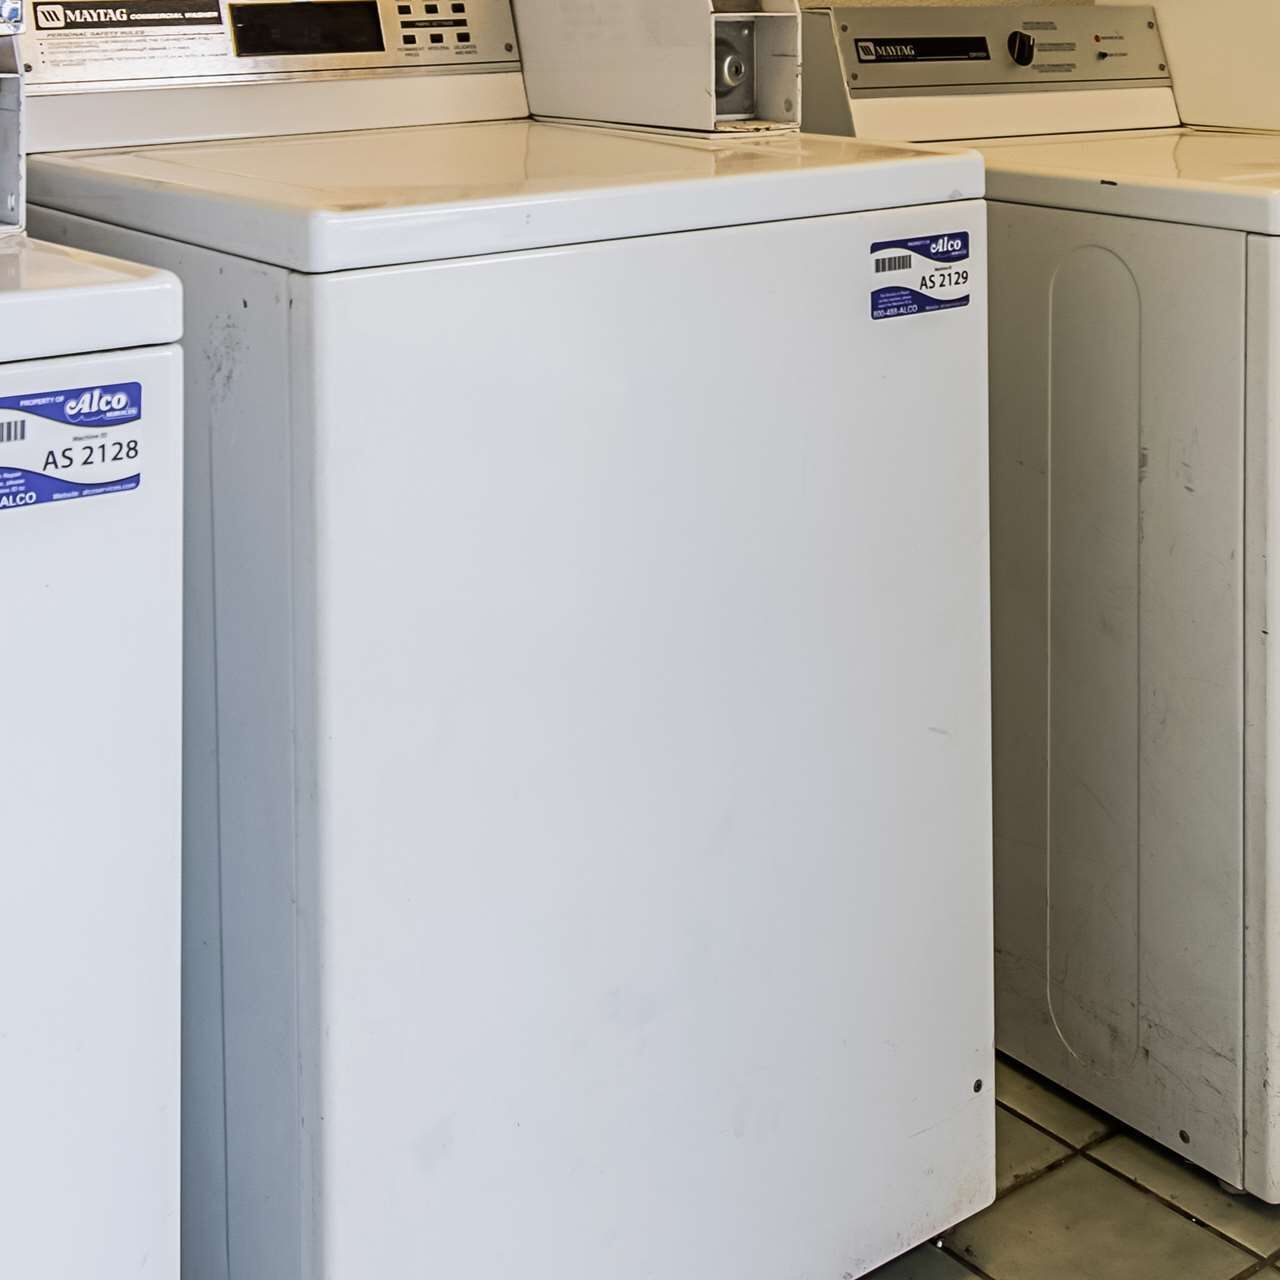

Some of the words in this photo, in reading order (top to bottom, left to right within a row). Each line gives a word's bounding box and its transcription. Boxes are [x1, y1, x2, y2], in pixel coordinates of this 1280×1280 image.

[65, 9, 128, 23] MAYTAG
[930, 236, 961, 253] Alco
[920, 275, 935, 290] AS
[939, 271, 968, 287] 2129
[65, 389, 128, 416] Alco
[42, 449, 73, 471] AS
[81, 440, 139, 465] 2128
